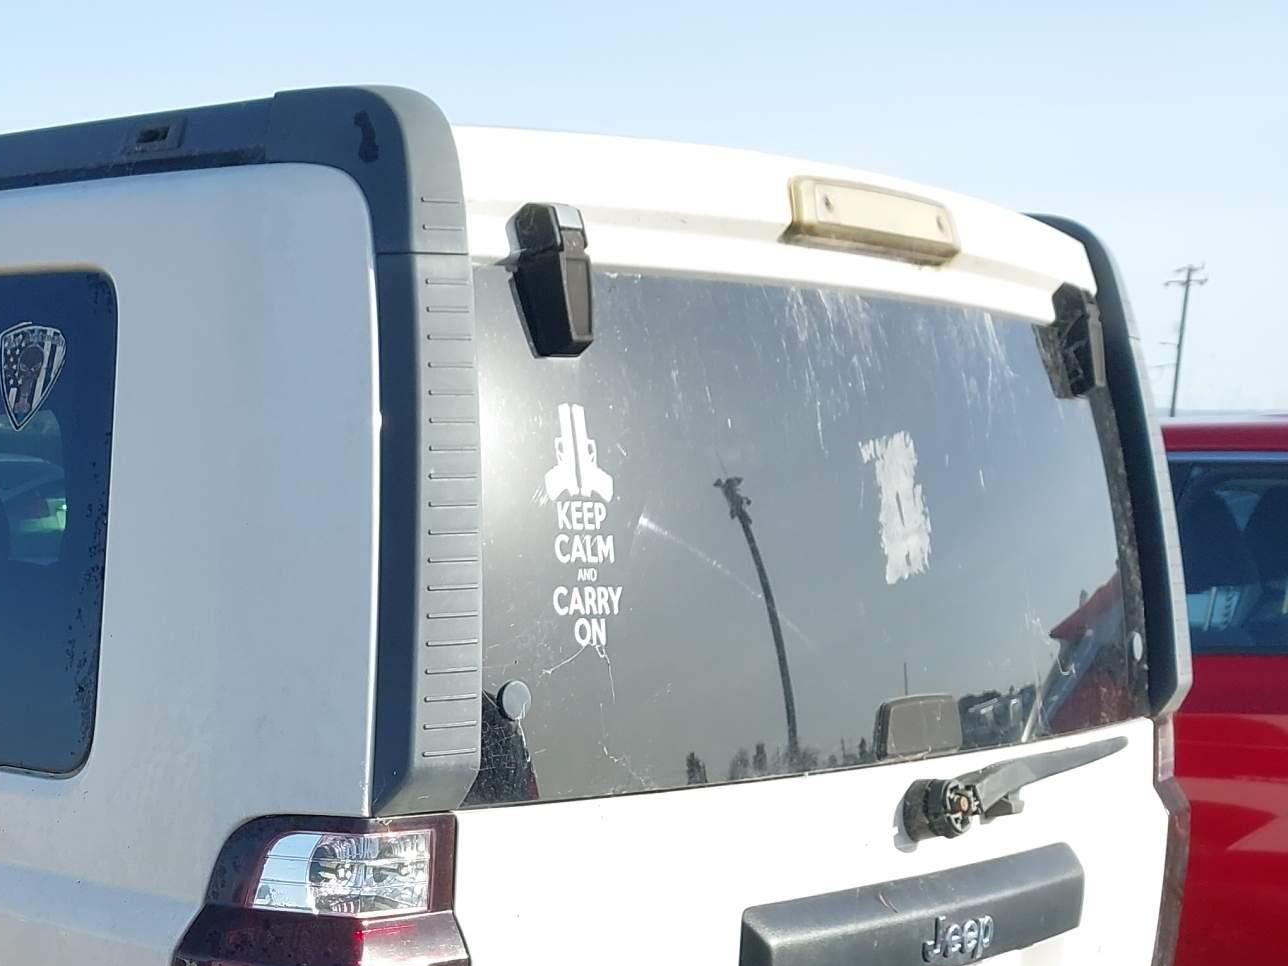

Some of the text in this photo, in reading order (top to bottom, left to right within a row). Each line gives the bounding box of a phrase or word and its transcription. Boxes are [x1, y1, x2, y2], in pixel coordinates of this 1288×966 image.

[557, 501, 607, 530] KEEP
[554, 534, 615, 563] CALM
[577, 567, 598, 582] AND
[552, 586, 623, 616] CARRY
[574, 617, 607, 646] ON
[922, 915, 993, 962] Jeep
